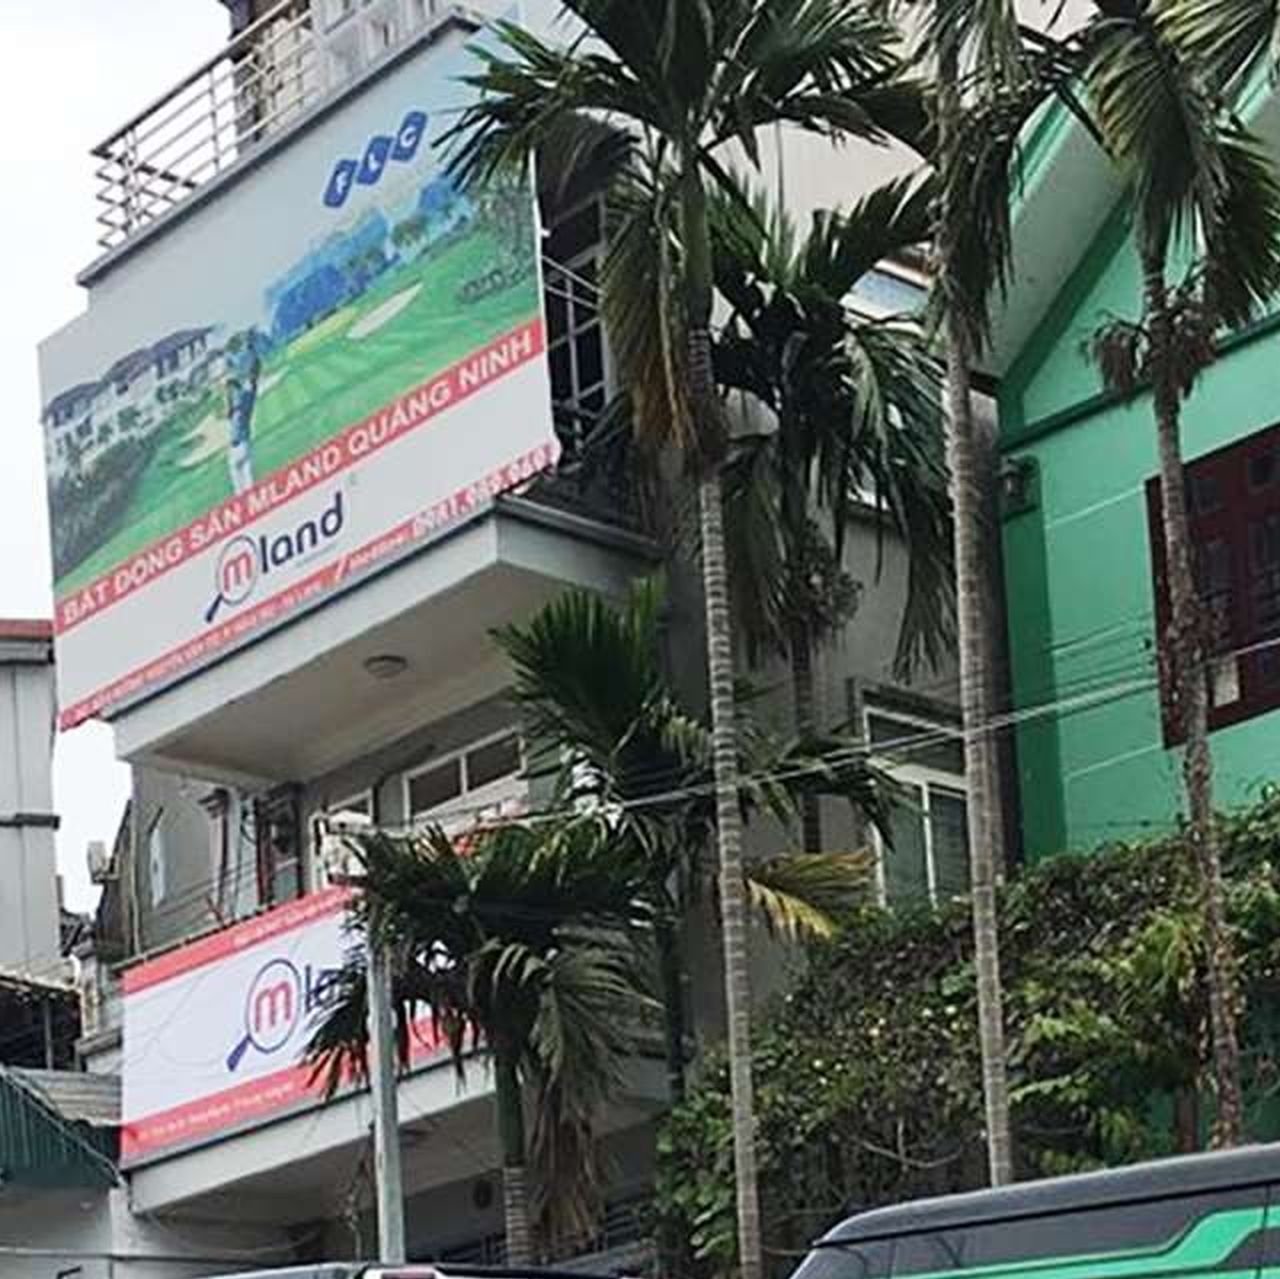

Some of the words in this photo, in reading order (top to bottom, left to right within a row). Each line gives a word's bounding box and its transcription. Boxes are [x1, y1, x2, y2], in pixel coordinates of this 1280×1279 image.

[329, 117, 423, 202] FLC
[247, 446, 340, 517] MLAND
[458, 330, 532, 392] NINH
[222, 491, 344, 592] mland
